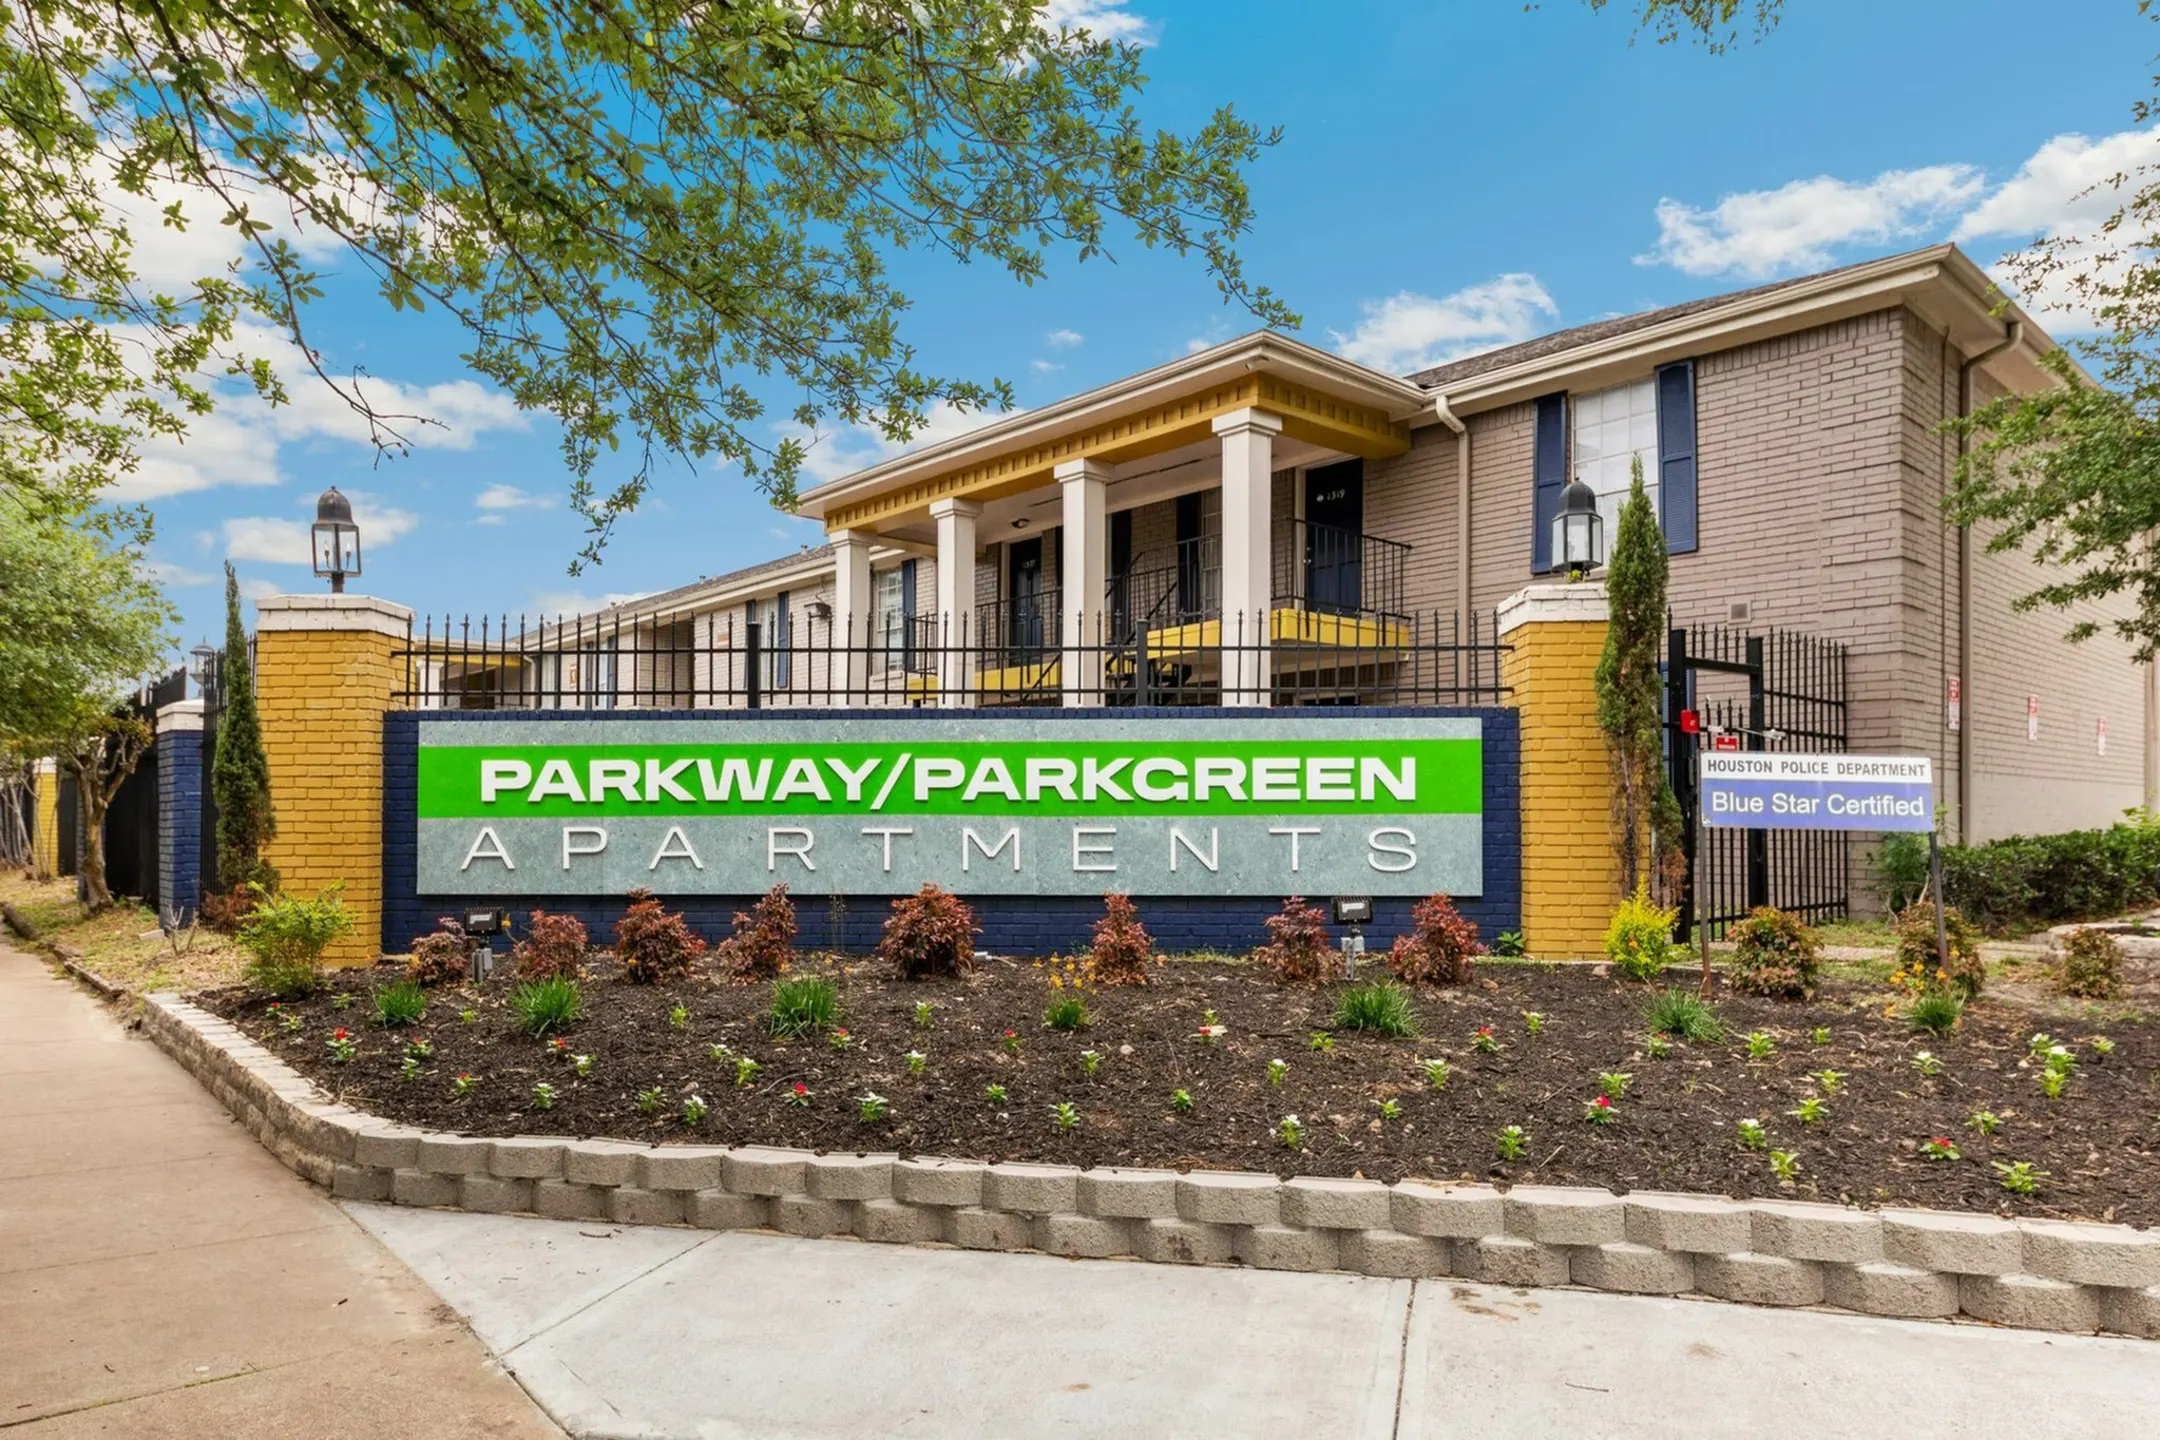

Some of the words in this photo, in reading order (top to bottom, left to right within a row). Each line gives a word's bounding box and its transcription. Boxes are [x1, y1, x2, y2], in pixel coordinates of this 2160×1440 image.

[480, 753, 1417, 811] PARKWAY/PARKGREEN
[1707, 759, 1773, 773] HOUSTON
[1781, 760, 1829, 775] POLICE
[1837, 762, 1926, 777] DEPARTMENT
[1712, 791, 1765, 813] Blue
[1772, 792, 1820, 814] Star
[1827, 794, 1924, 816] Certified
[460, 825, 1418, 873] APARTMENTS
